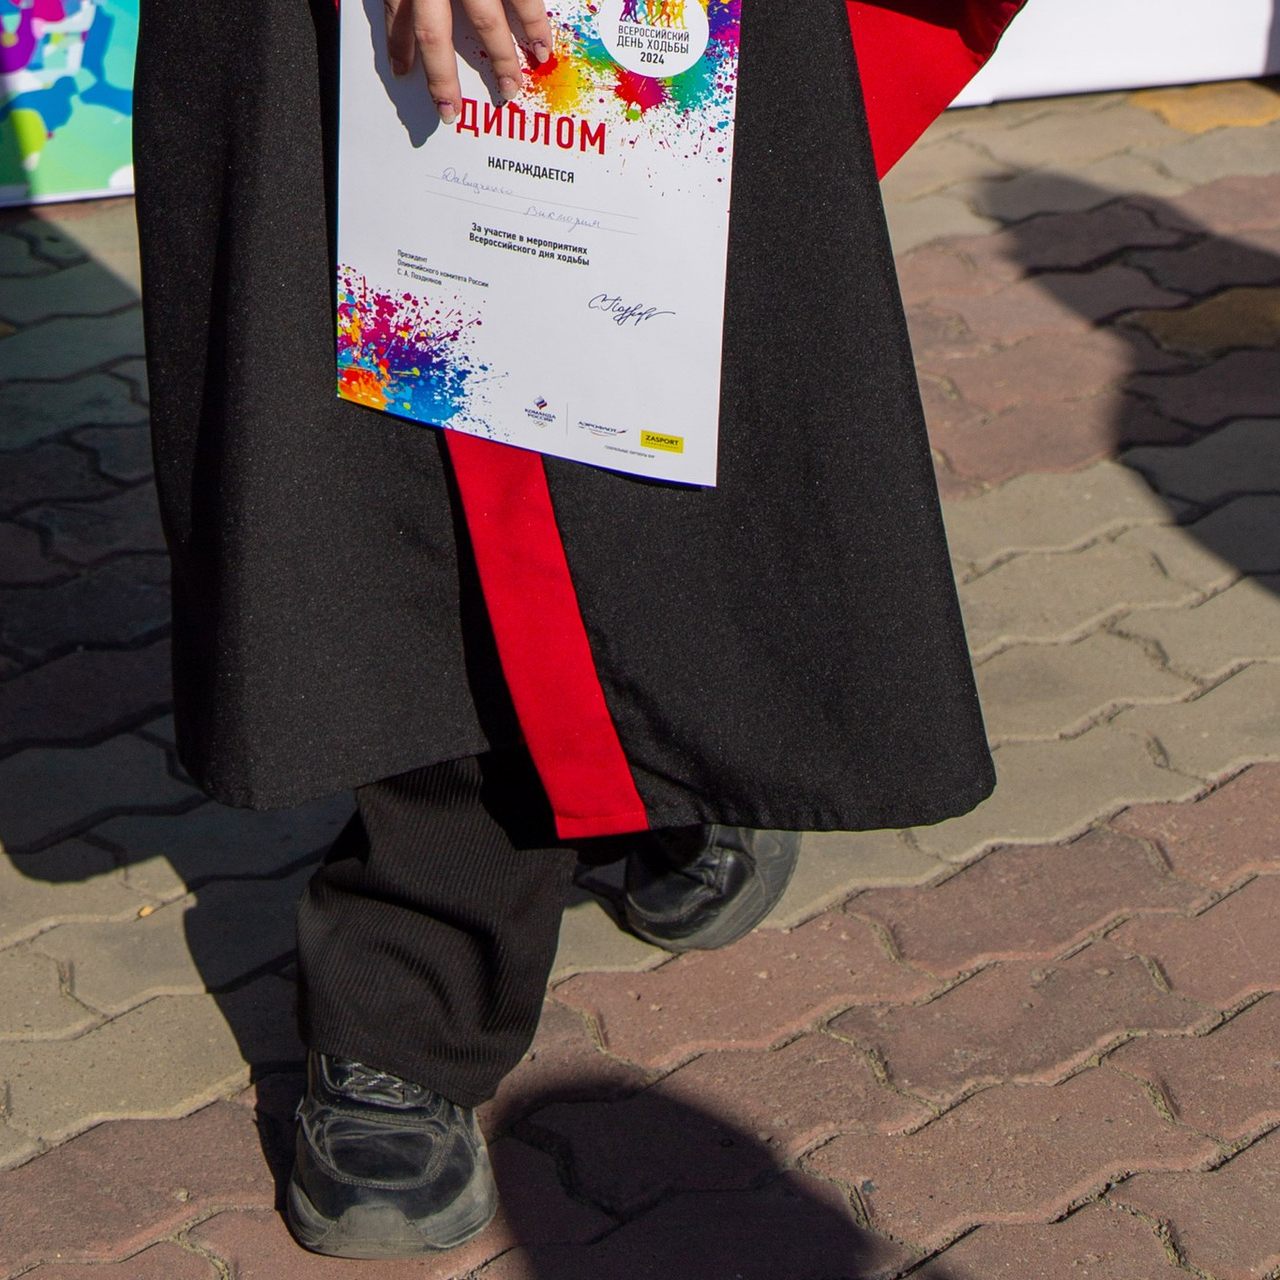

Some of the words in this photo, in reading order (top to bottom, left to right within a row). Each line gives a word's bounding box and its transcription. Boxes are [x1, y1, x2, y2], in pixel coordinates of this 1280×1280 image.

[618, 24, 690, 42] ВСЕРОССИЙСКИЙ
[617, 35, 644, 49] ДЕНЬ
[647, 39, 689, 54] ХОДЬБЫ
[640, 51, 665, 65] 2024
[456, 97, 607, 156] ДИПЛОМ
[487, 155, 575, 183] НАГРАЖДАЕТСЯ
[471, 222, 482, 233] За
[483, 226, 517, 242] участие
[526, 236, 588, 255] мероприятиях
[397, 249, 428, 264] Президент
[469, 232, 537, 256] Всероссийского
[538, 249, 555, 260] дня
[556, 252, 590, 266] ходьбы
[645, 434, 679, 446] ZASPORT
